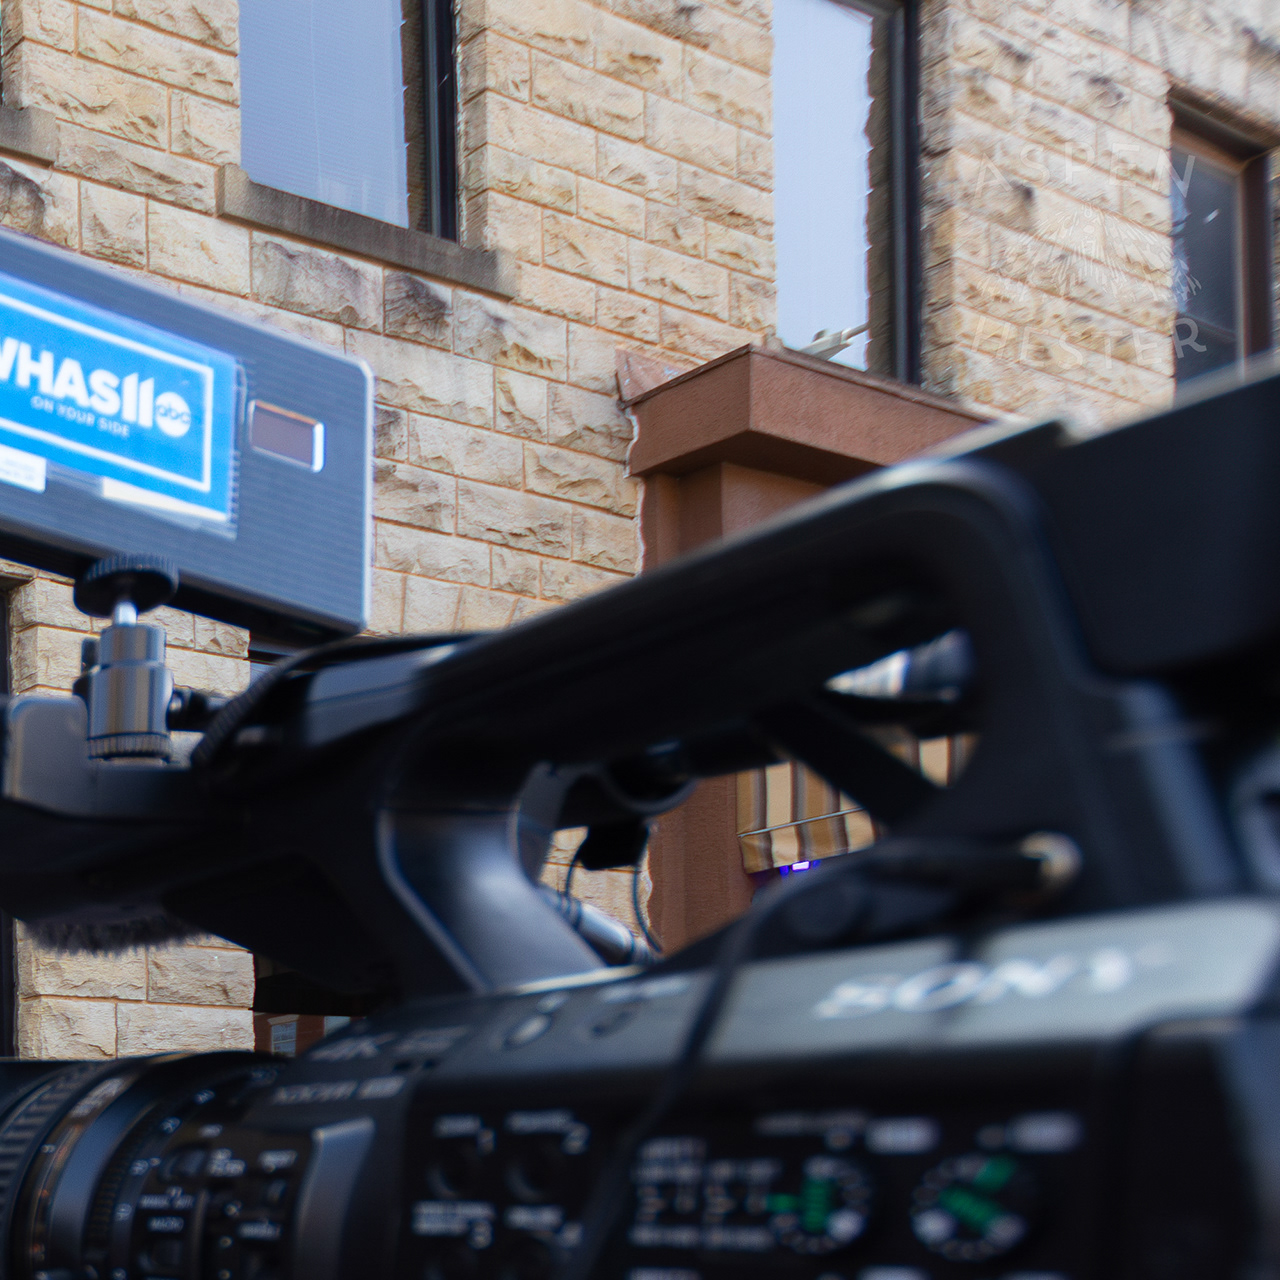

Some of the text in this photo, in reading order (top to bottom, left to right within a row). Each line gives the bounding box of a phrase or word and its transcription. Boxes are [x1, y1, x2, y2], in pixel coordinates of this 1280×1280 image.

[30, 395, 130, 438] ON YOUR SIDE
